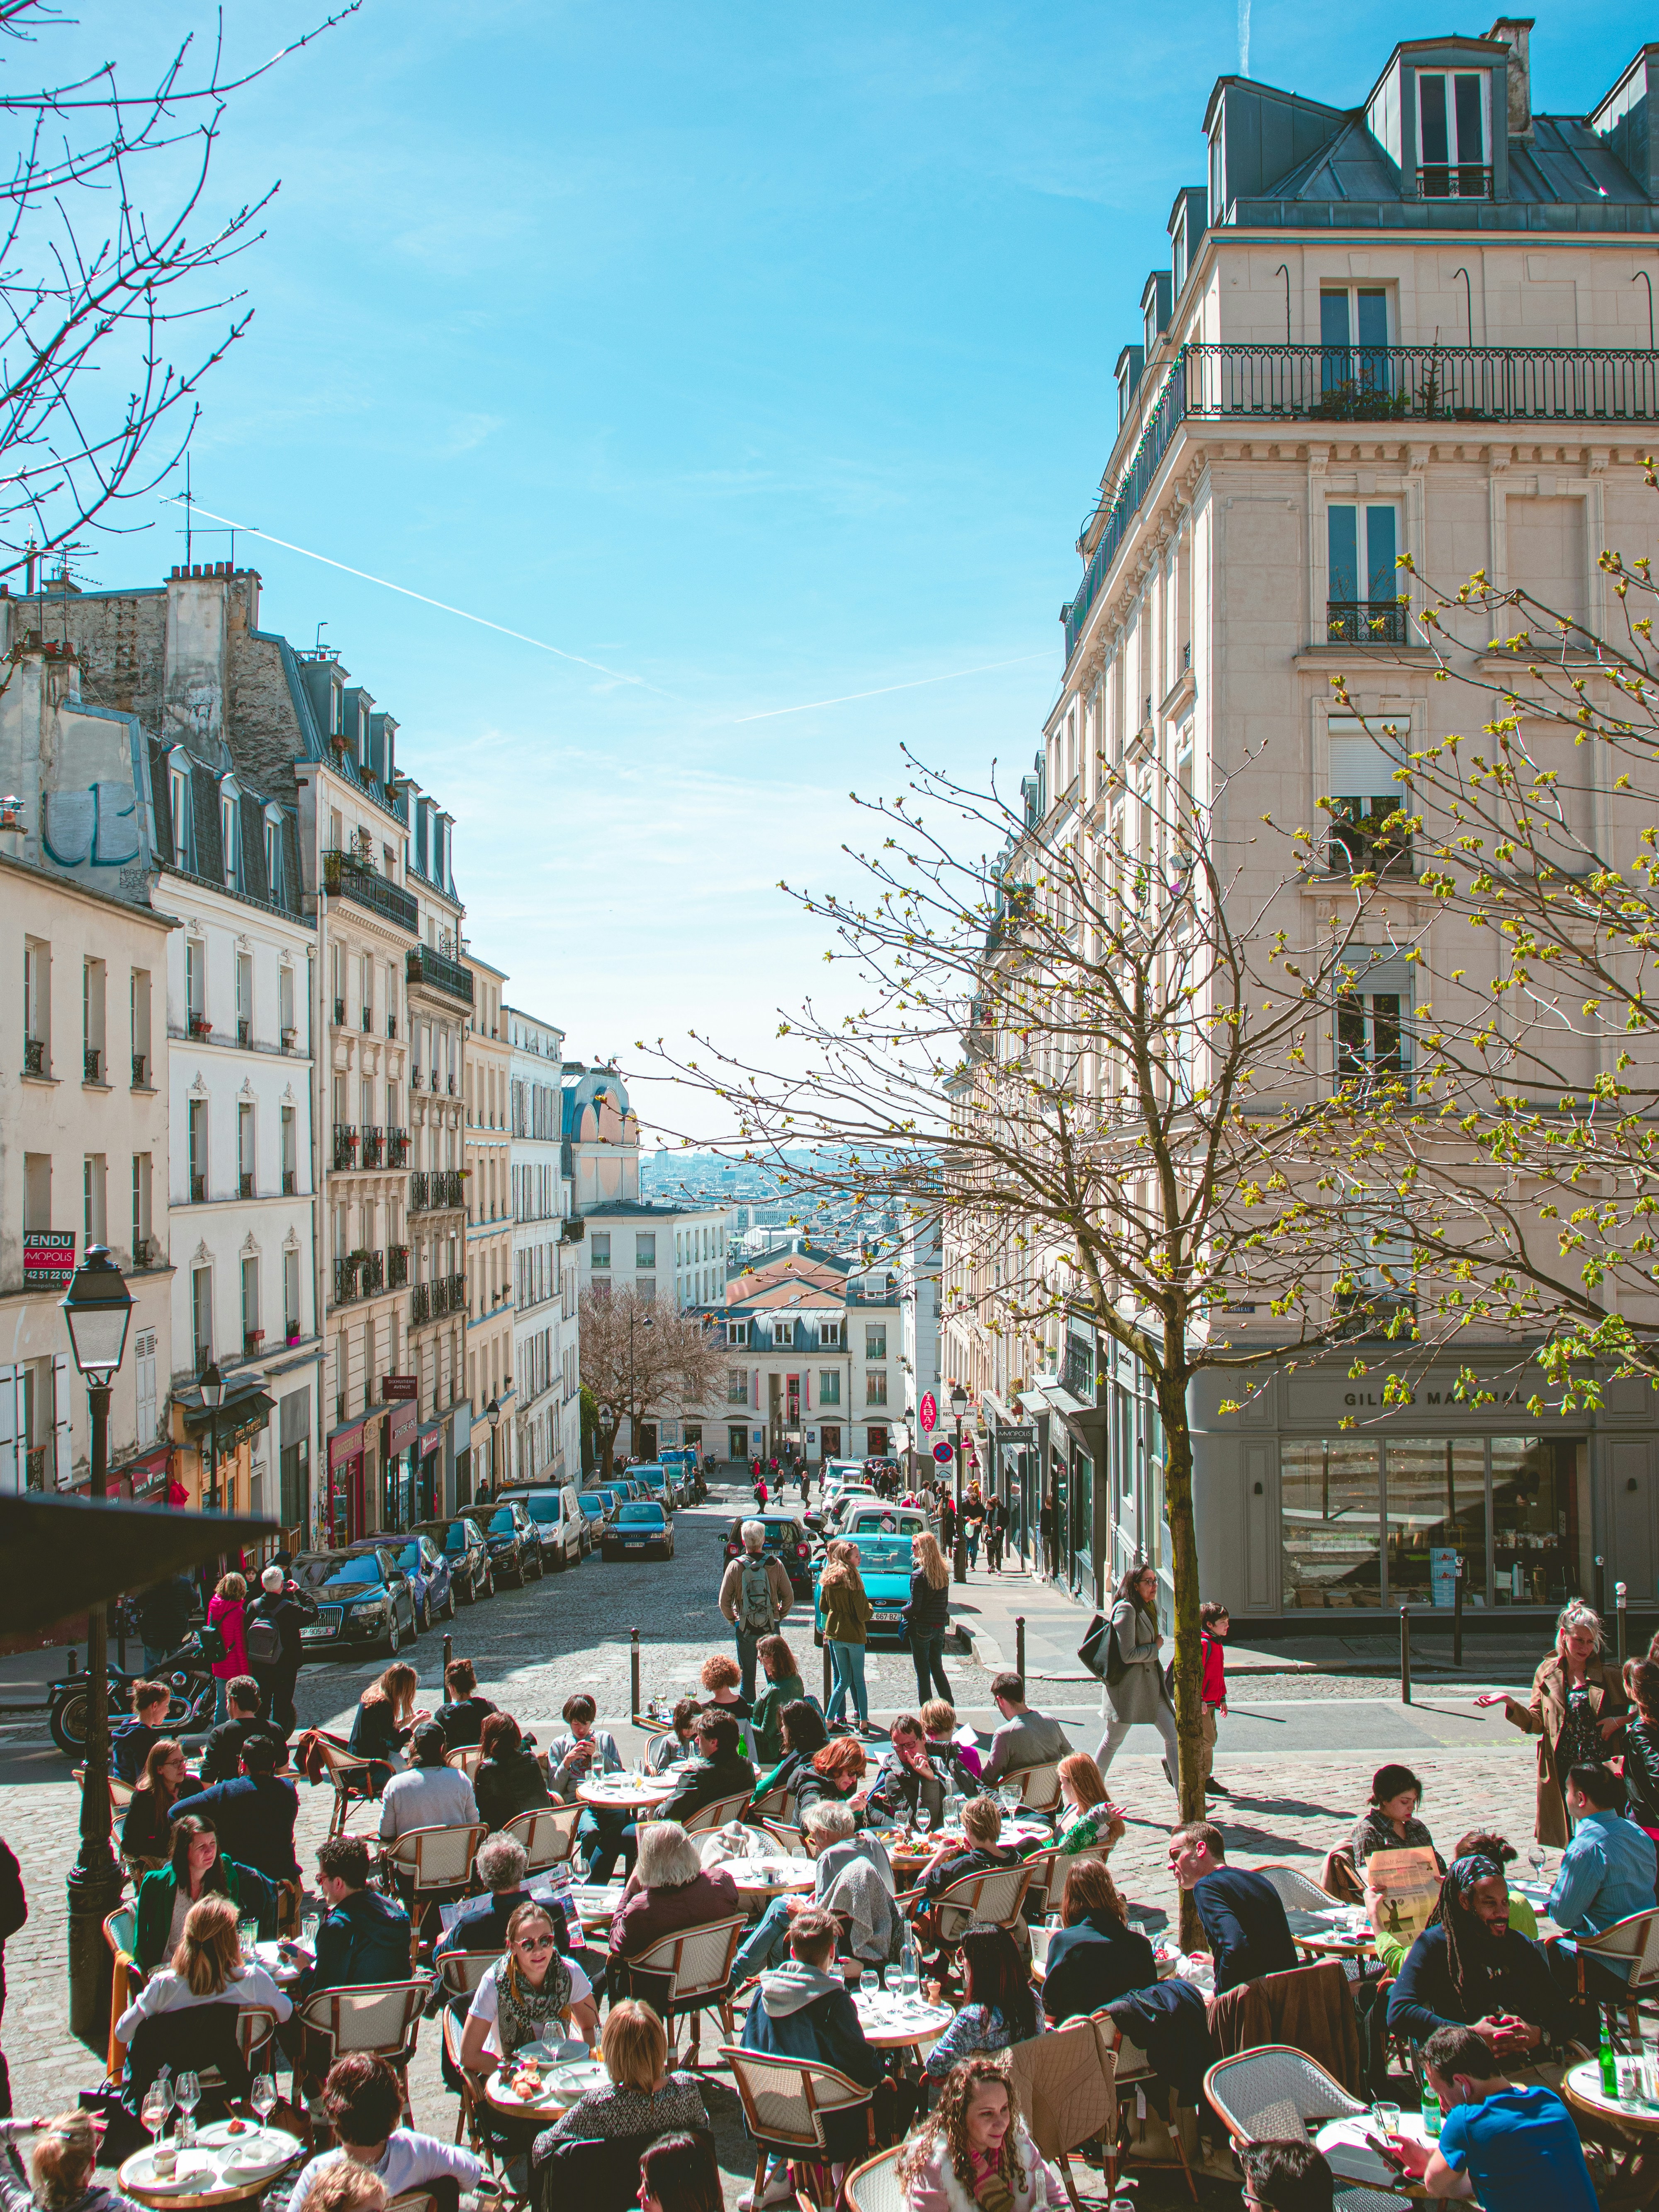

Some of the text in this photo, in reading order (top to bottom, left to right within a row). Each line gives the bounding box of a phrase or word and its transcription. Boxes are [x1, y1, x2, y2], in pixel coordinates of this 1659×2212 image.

[24, 1235, 71, 1246] VENDU
[27, 1271, 38, 1279] 42
[39, 1271, 49, 1279] 51
[50, 1271, 61, 1279] 22
[62, 1271, 72, 1279] 00
[923, 1393, 933, 1431] TABAC
